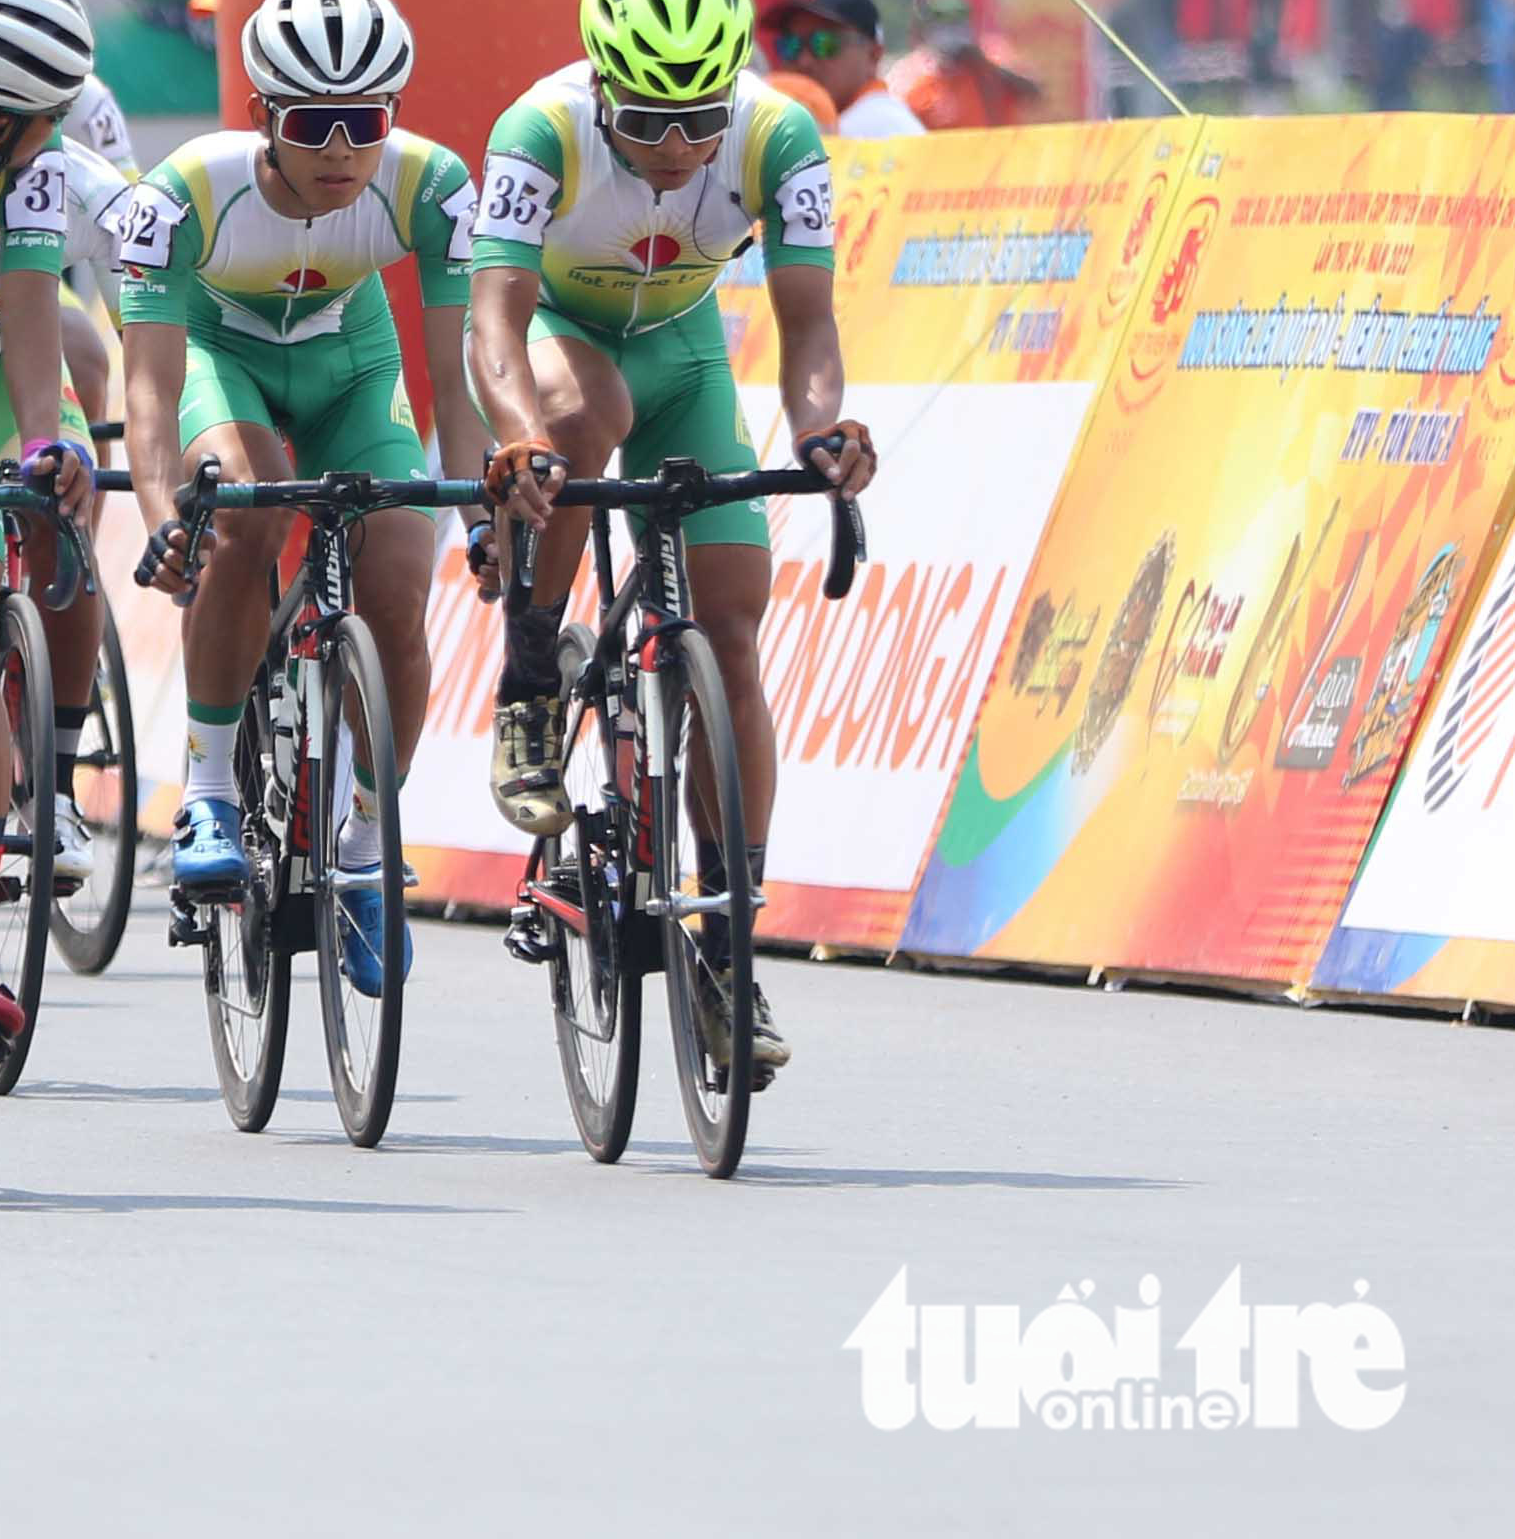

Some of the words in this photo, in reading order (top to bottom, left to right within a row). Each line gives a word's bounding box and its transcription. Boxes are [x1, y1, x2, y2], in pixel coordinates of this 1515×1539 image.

[488, 174, 540, 226] 35
[820, 562, 974, 771] DONG
[918, 563, 1007, 772] A
